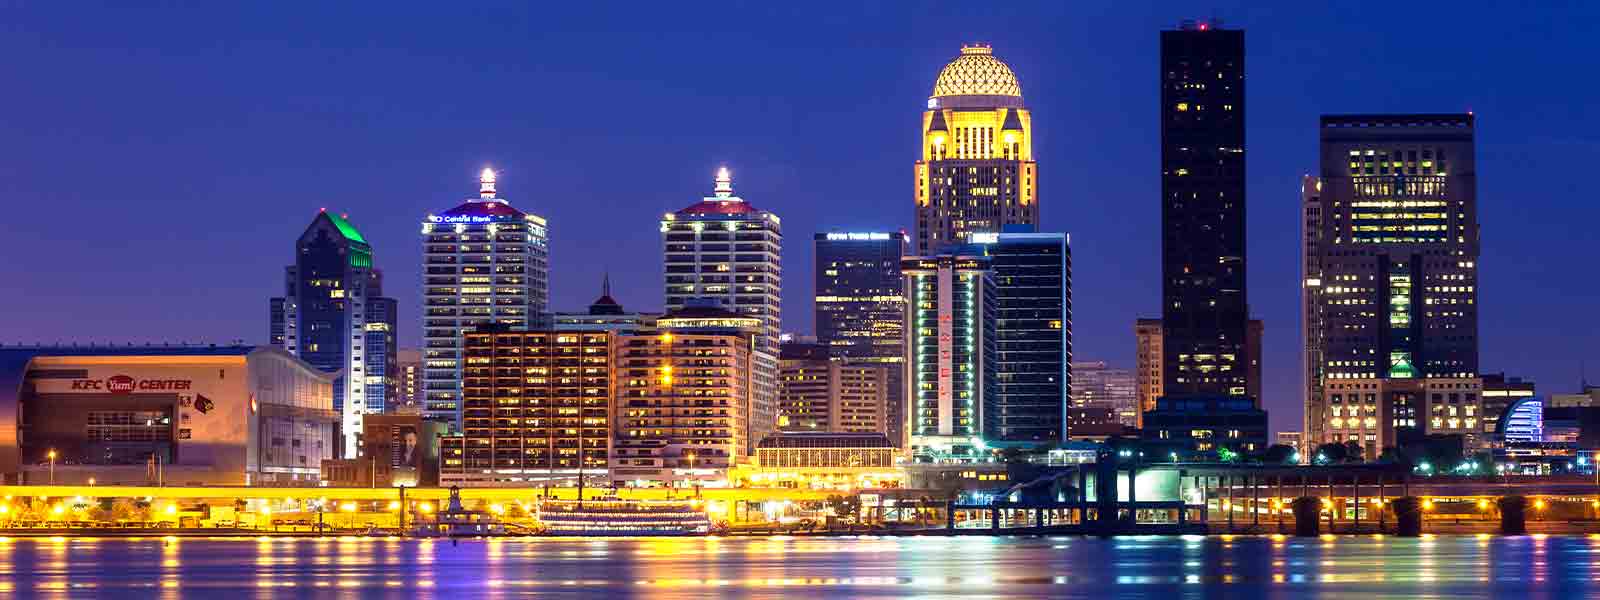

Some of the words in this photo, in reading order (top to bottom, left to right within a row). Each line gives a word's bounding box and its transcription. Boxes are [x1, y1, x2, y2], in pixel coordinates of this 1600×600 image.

[71, 380, 103, 390] KFC
[110, 379, 135, 391] Yum!
[139, 380, 192, 390] CENTER
